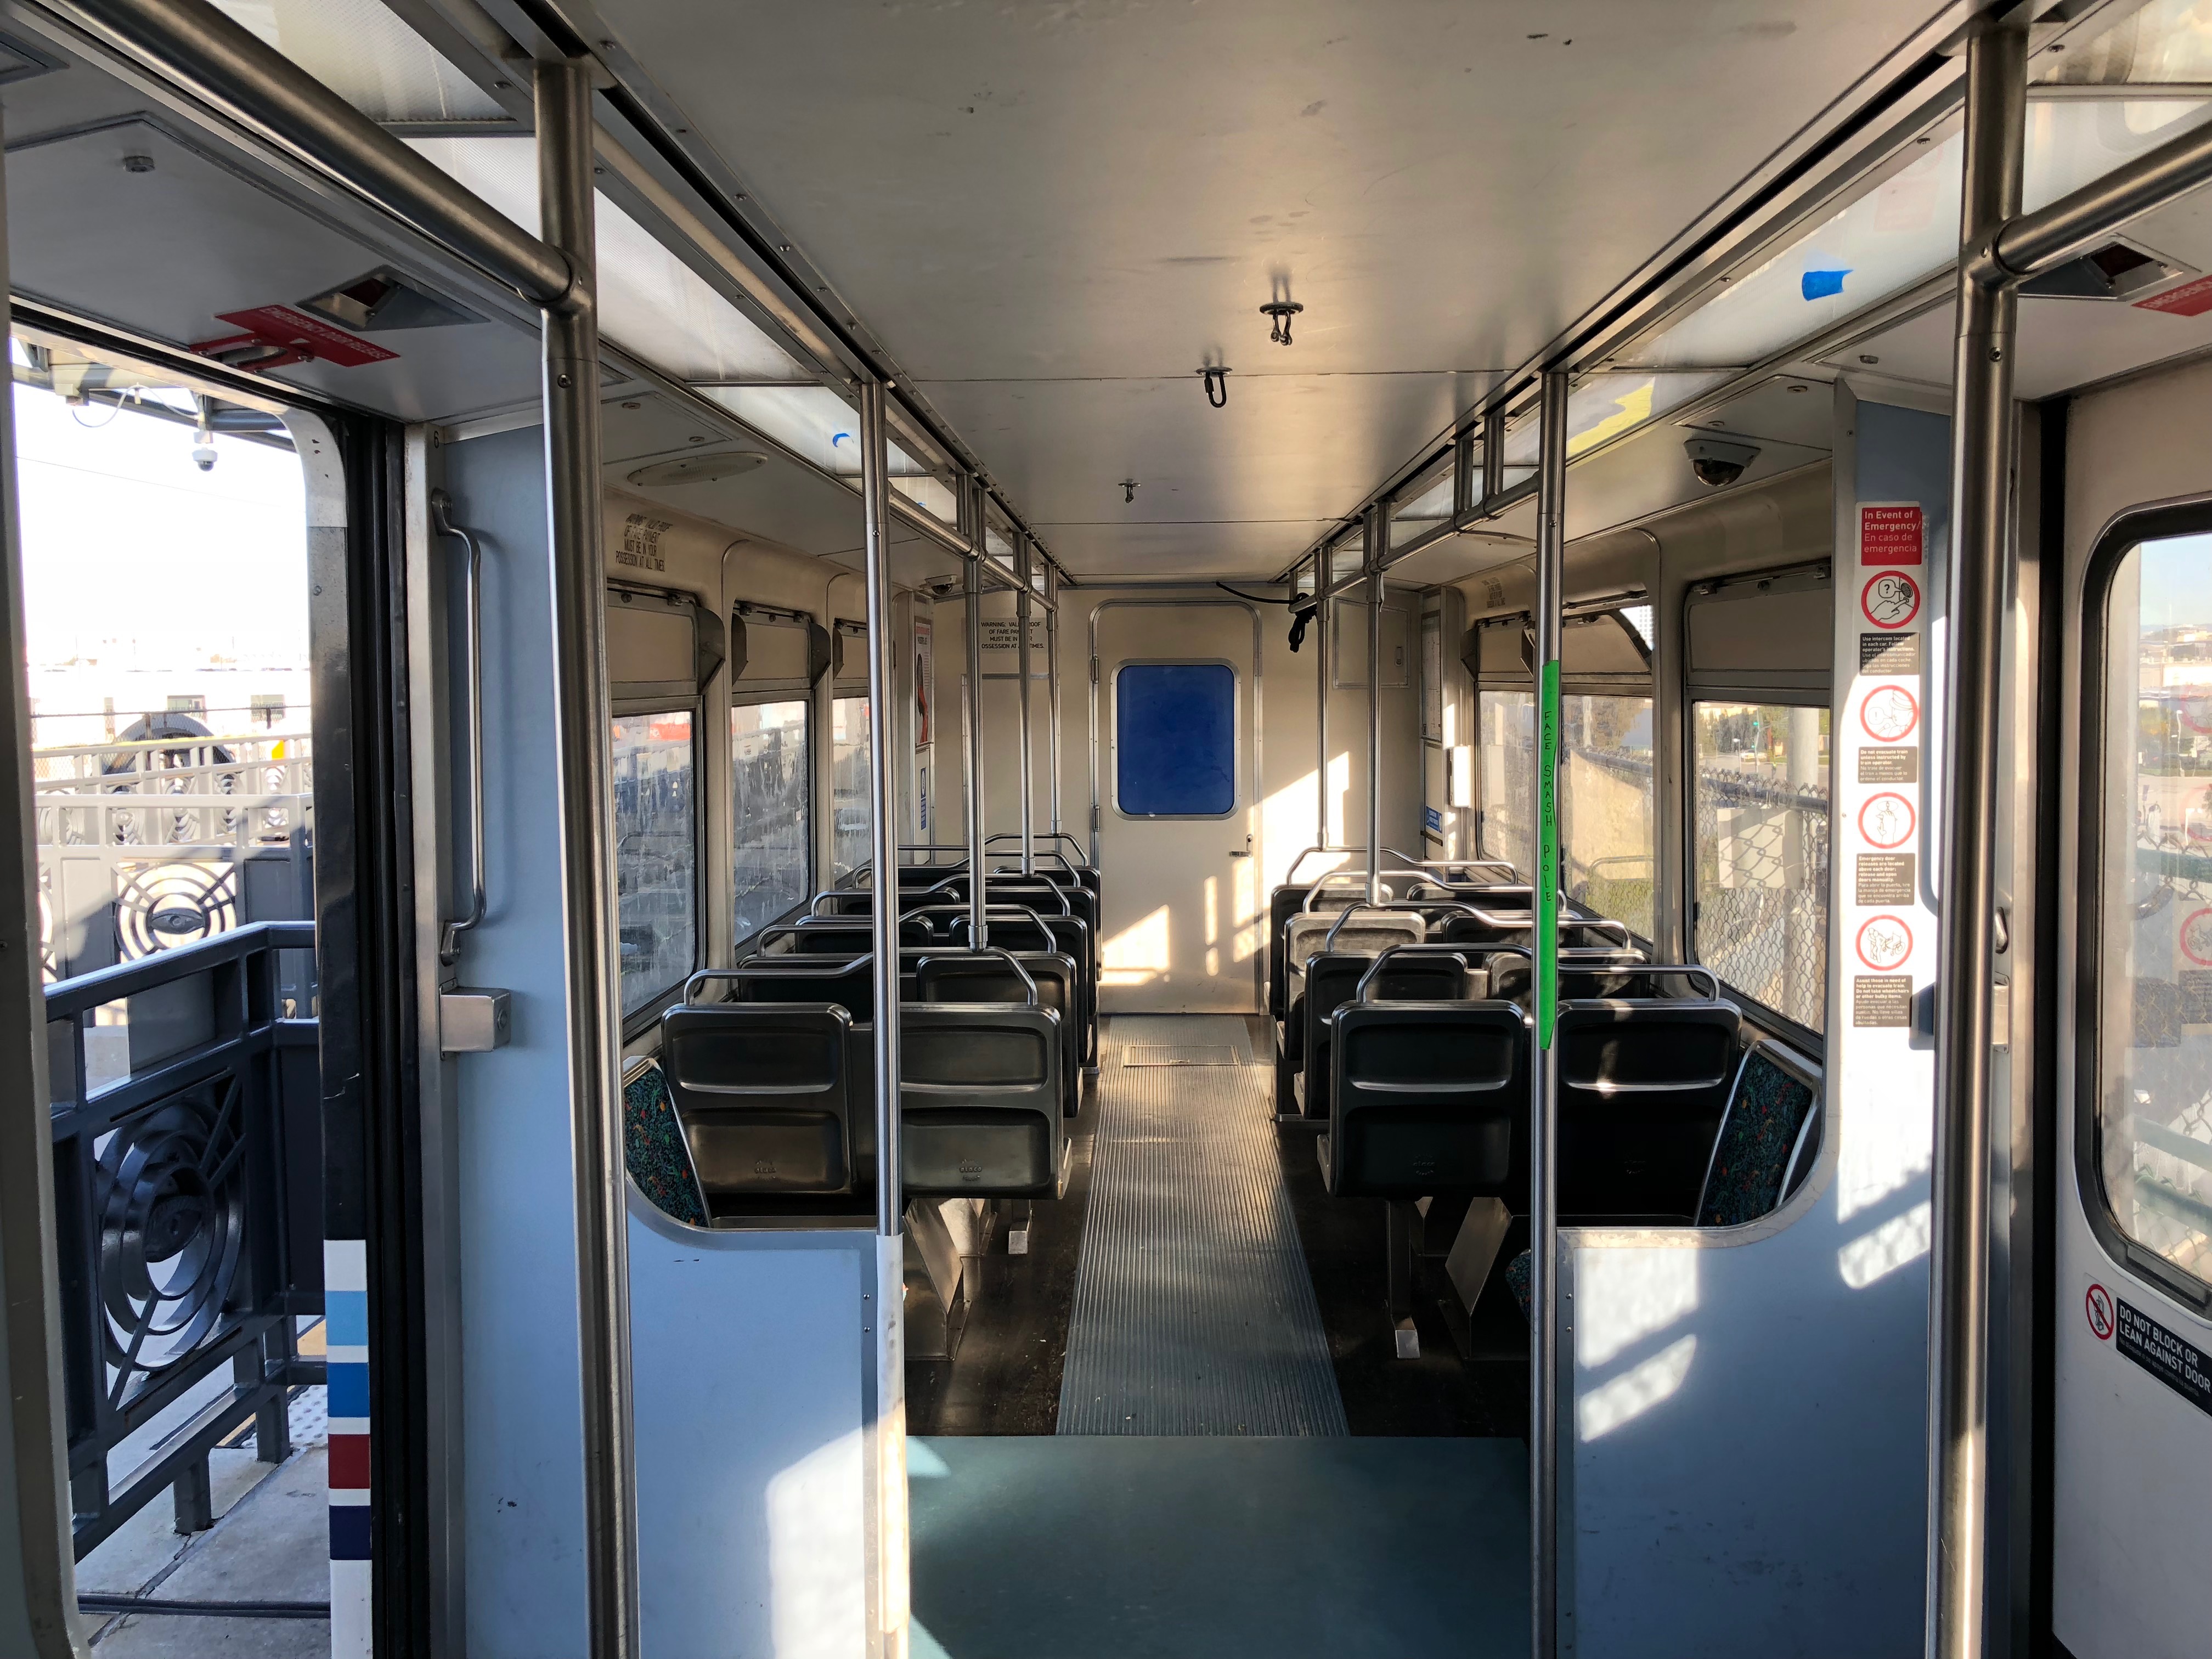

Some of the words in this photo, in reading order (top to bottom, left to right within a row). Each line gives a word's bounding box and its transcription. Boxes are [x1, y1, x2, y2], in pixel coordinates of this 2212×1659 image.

[1865, 521, 1921, 532] Emergency/
[1876, 511, 1901, 519] Event
[1865, 544, 1917, 554] emergencia
[1544, 710, 1552, 750] FACE
[1543, 765, 1553, 826] SMASH
[1542, 844, 1551, 901] POLE
[2120, 1305, 2131, 1322] DO
[2134, 1314, 2151, 1336] NOT
[2153, 1327, 2183, 1358] BLOCK
[2185, 1348, 2198, 1368] OR
[2120, 1321, 2142, 1346] LEAN
[2145, 1338, 2183, 1373] AGAINST
[2185, 1364, 2210, 1393] DOOR
